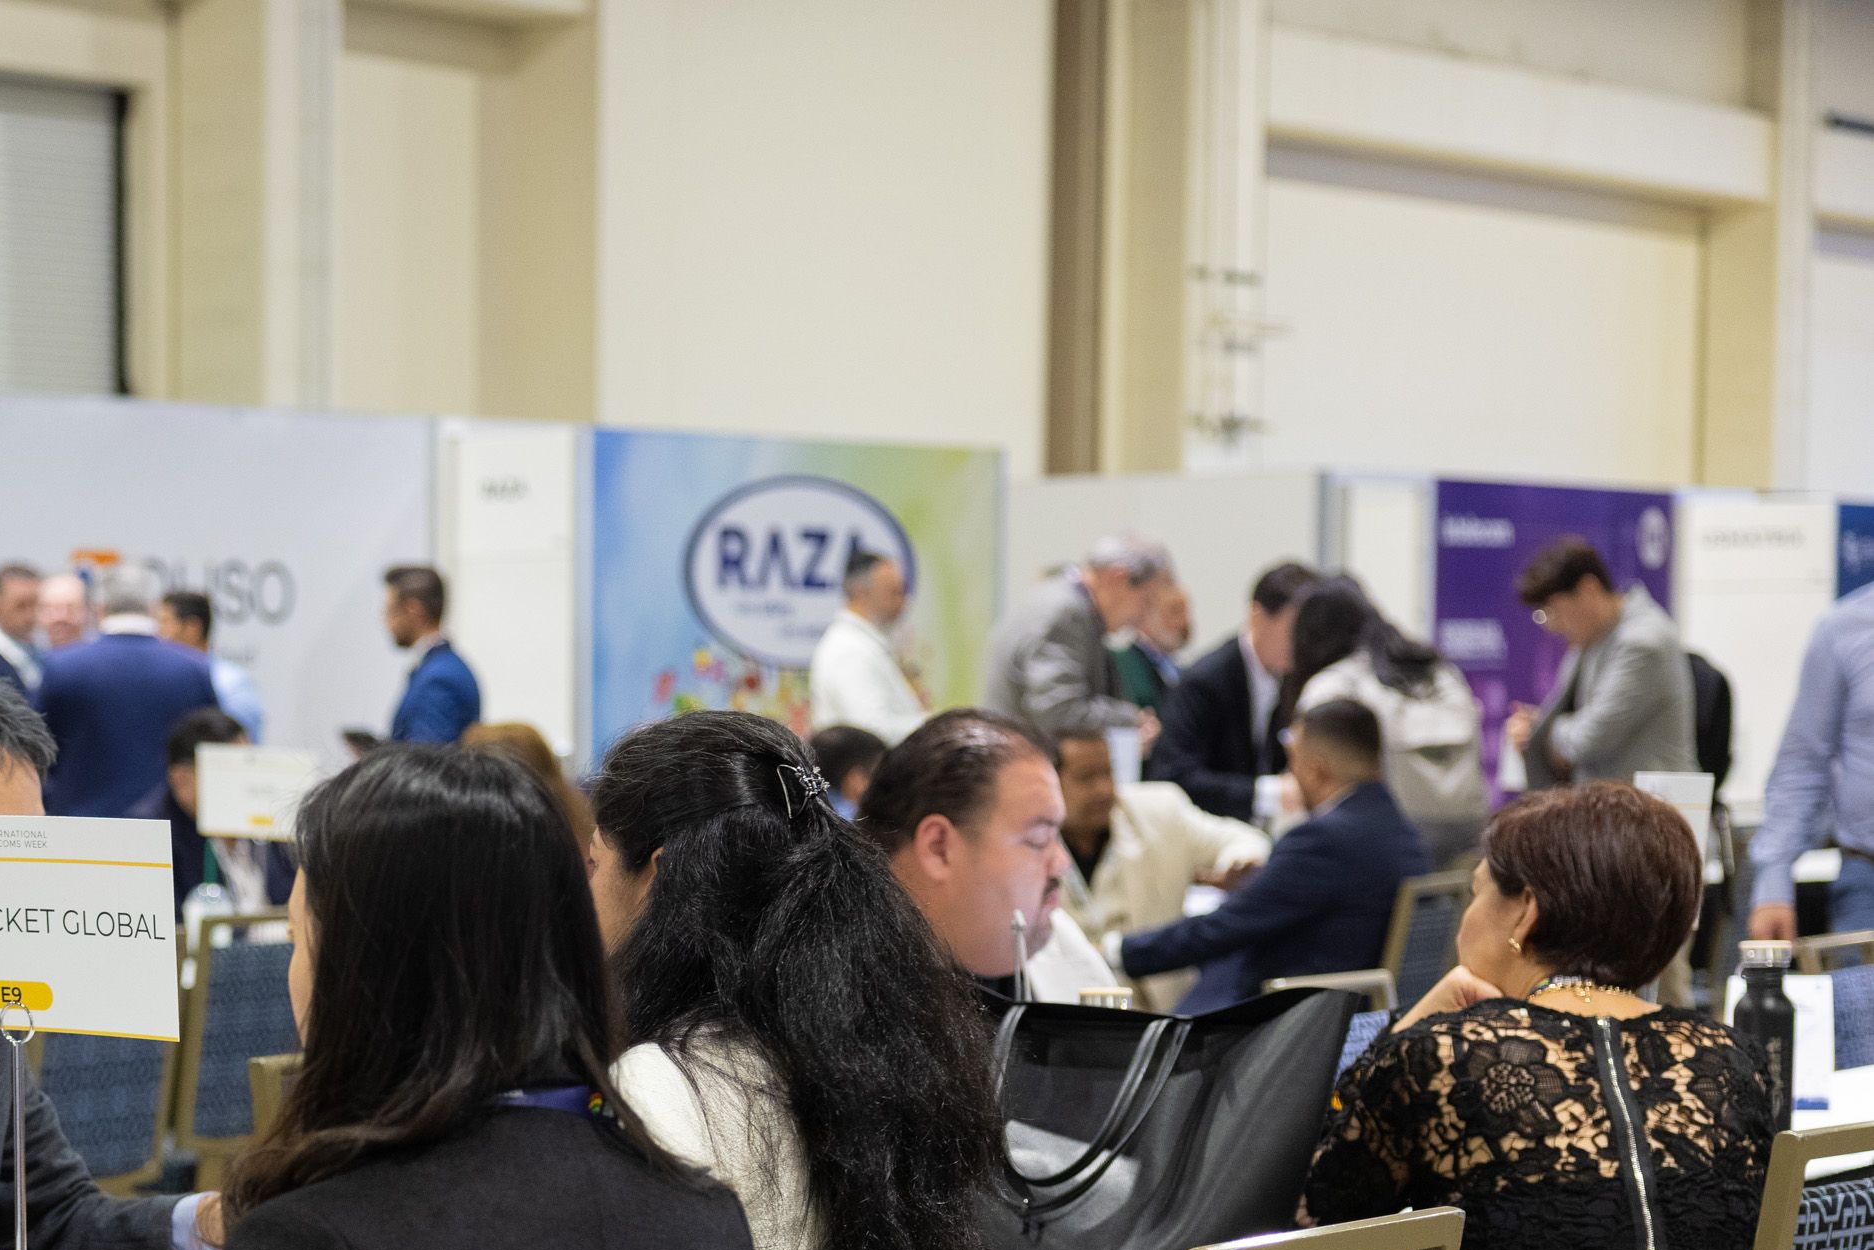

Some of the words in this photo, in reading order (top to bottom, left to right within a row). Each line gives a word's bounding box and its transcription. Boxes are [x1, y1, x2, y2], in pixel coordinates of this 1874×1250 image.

[25, 840, 48, 849] WEEK
[62, 909, 167, 941] GLOBAL
[0, 986, 22, 1004] E9
